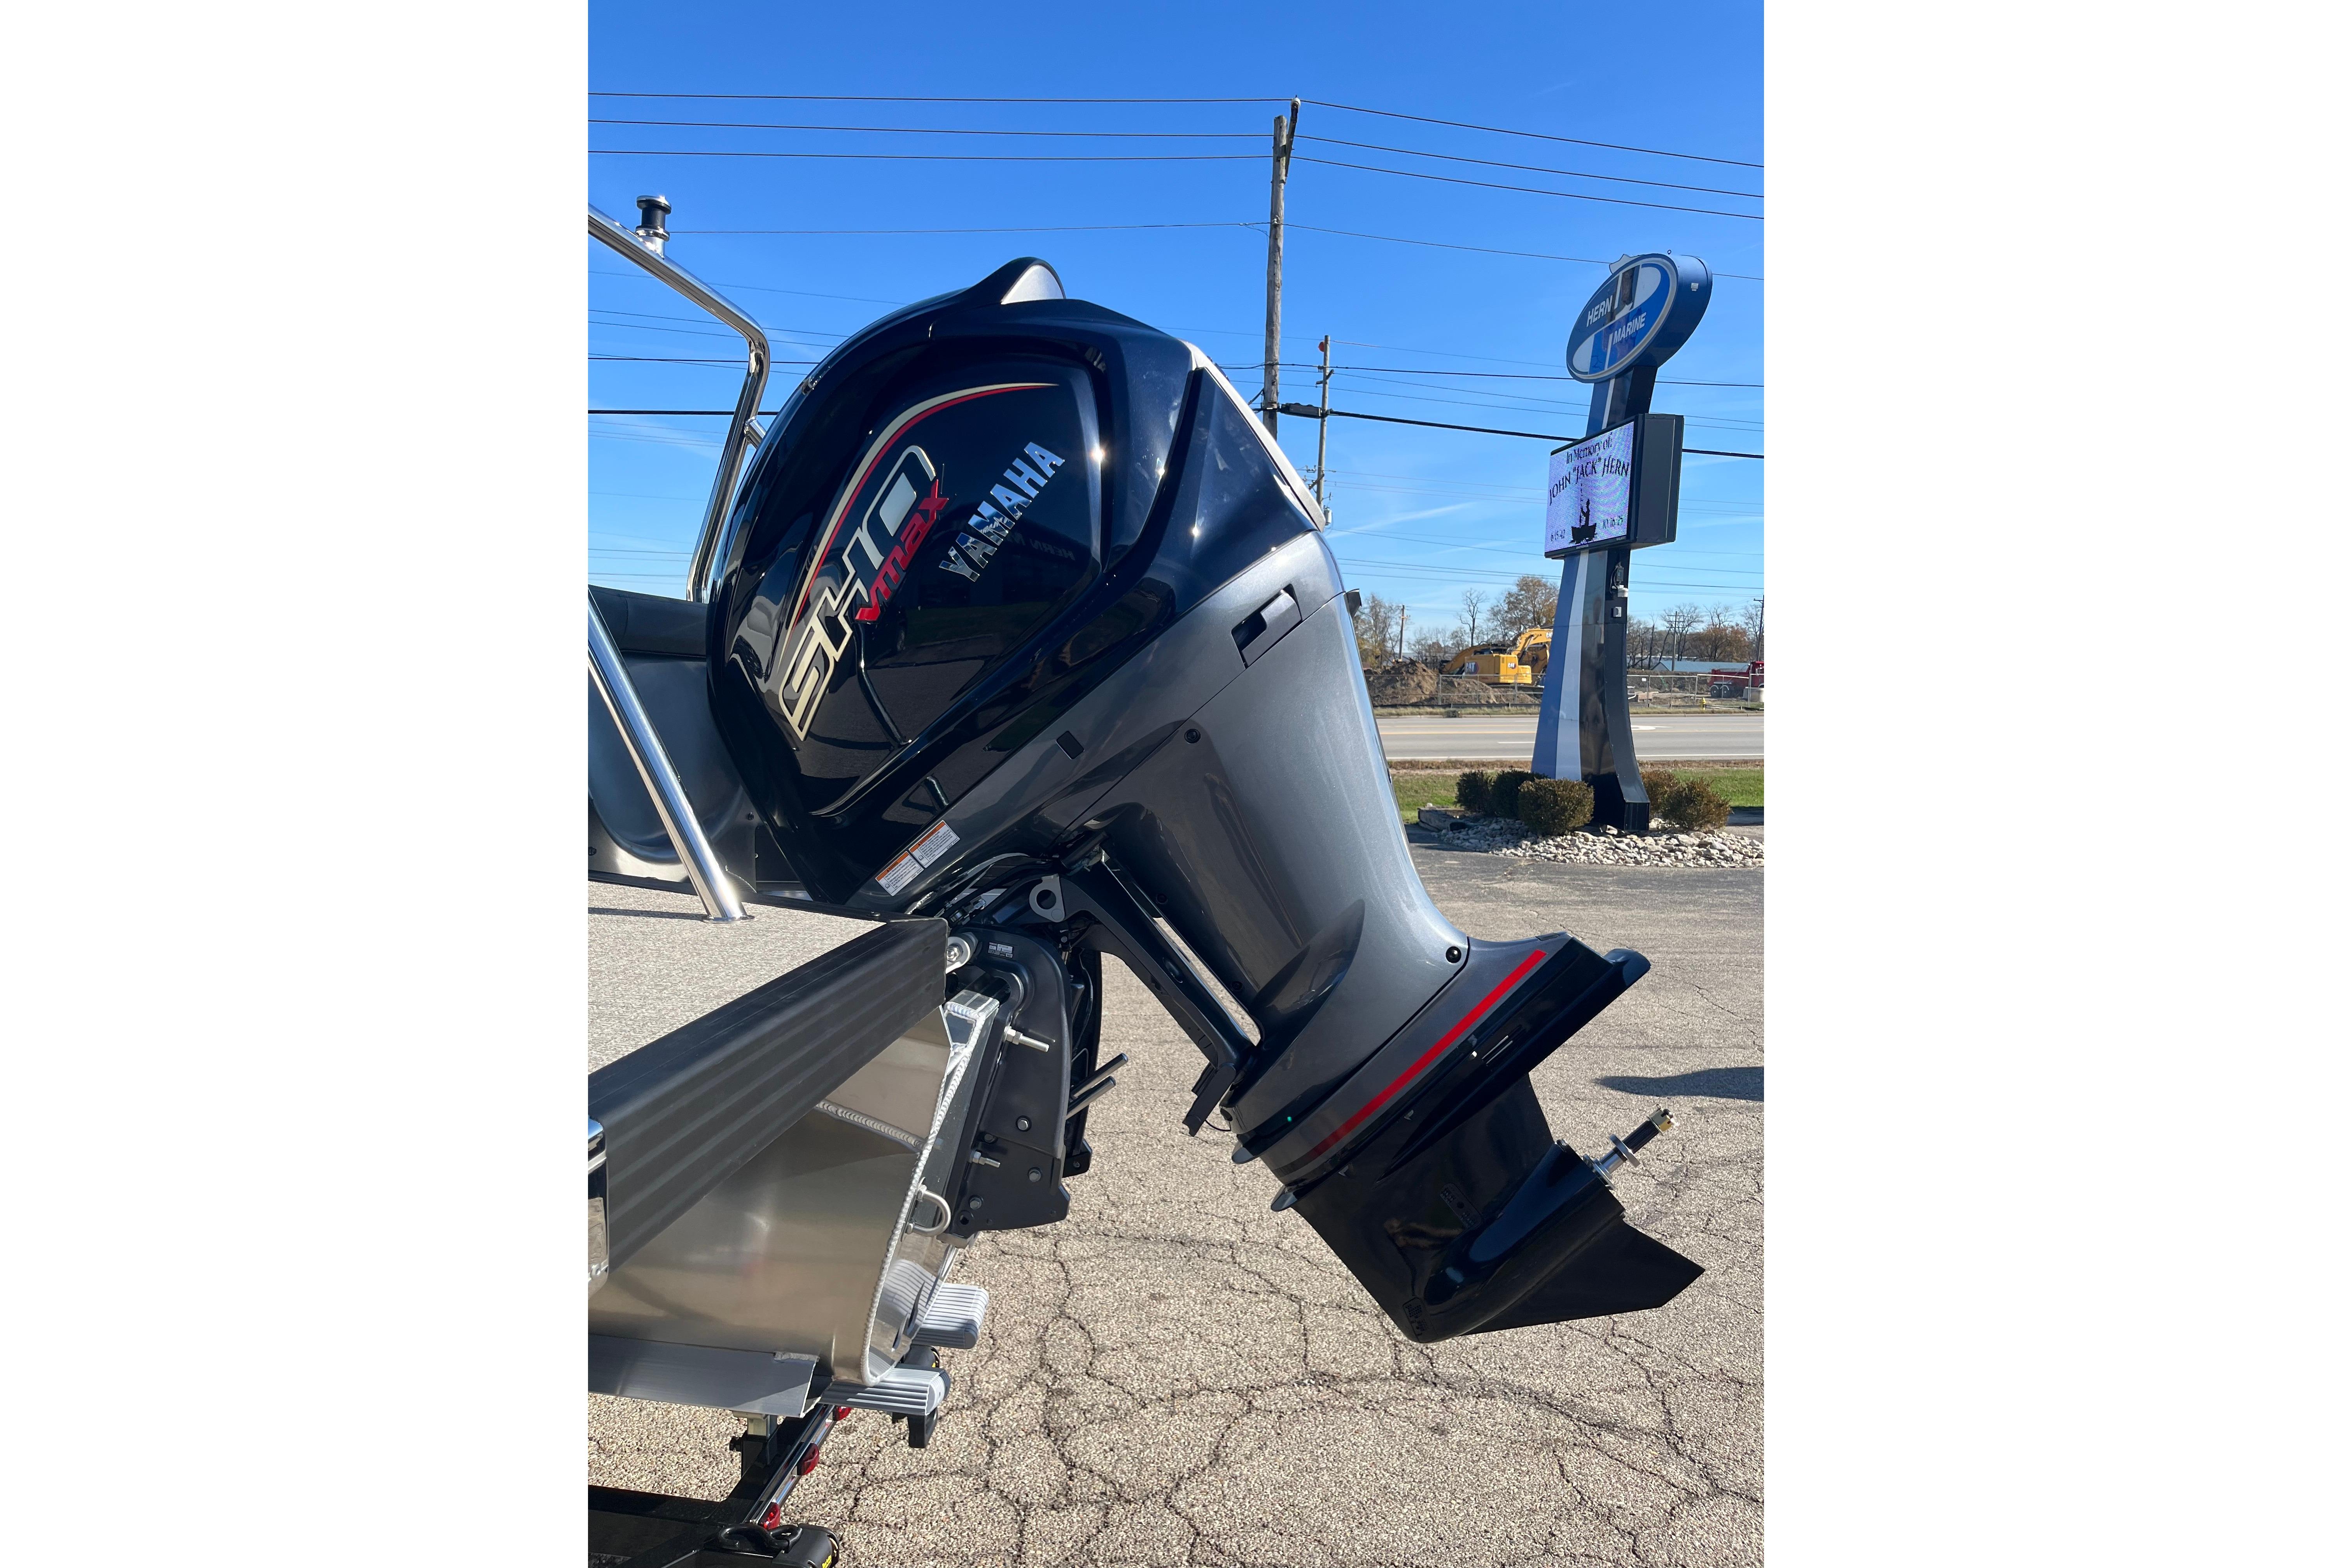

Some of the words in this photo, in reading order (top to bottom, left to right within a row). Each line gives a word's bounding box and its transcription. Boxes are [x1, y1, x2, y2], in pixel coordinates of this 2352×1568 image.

[1586, 295, 1613, 327] HERN
[1613, 312, 1647, 345] MARINE
[1574, 442, 1600, 460] Memory
[1549, 471, 1571, 506] JOHN
[1573, 457, 1602, 484] "JACK"
[1602, 455, 1629, 477] HERN
[938, 441, 1066, 582] YAMAHA
[779, 445, 936, 741] SHO
[1465, 662, 1475, 672] CAT
